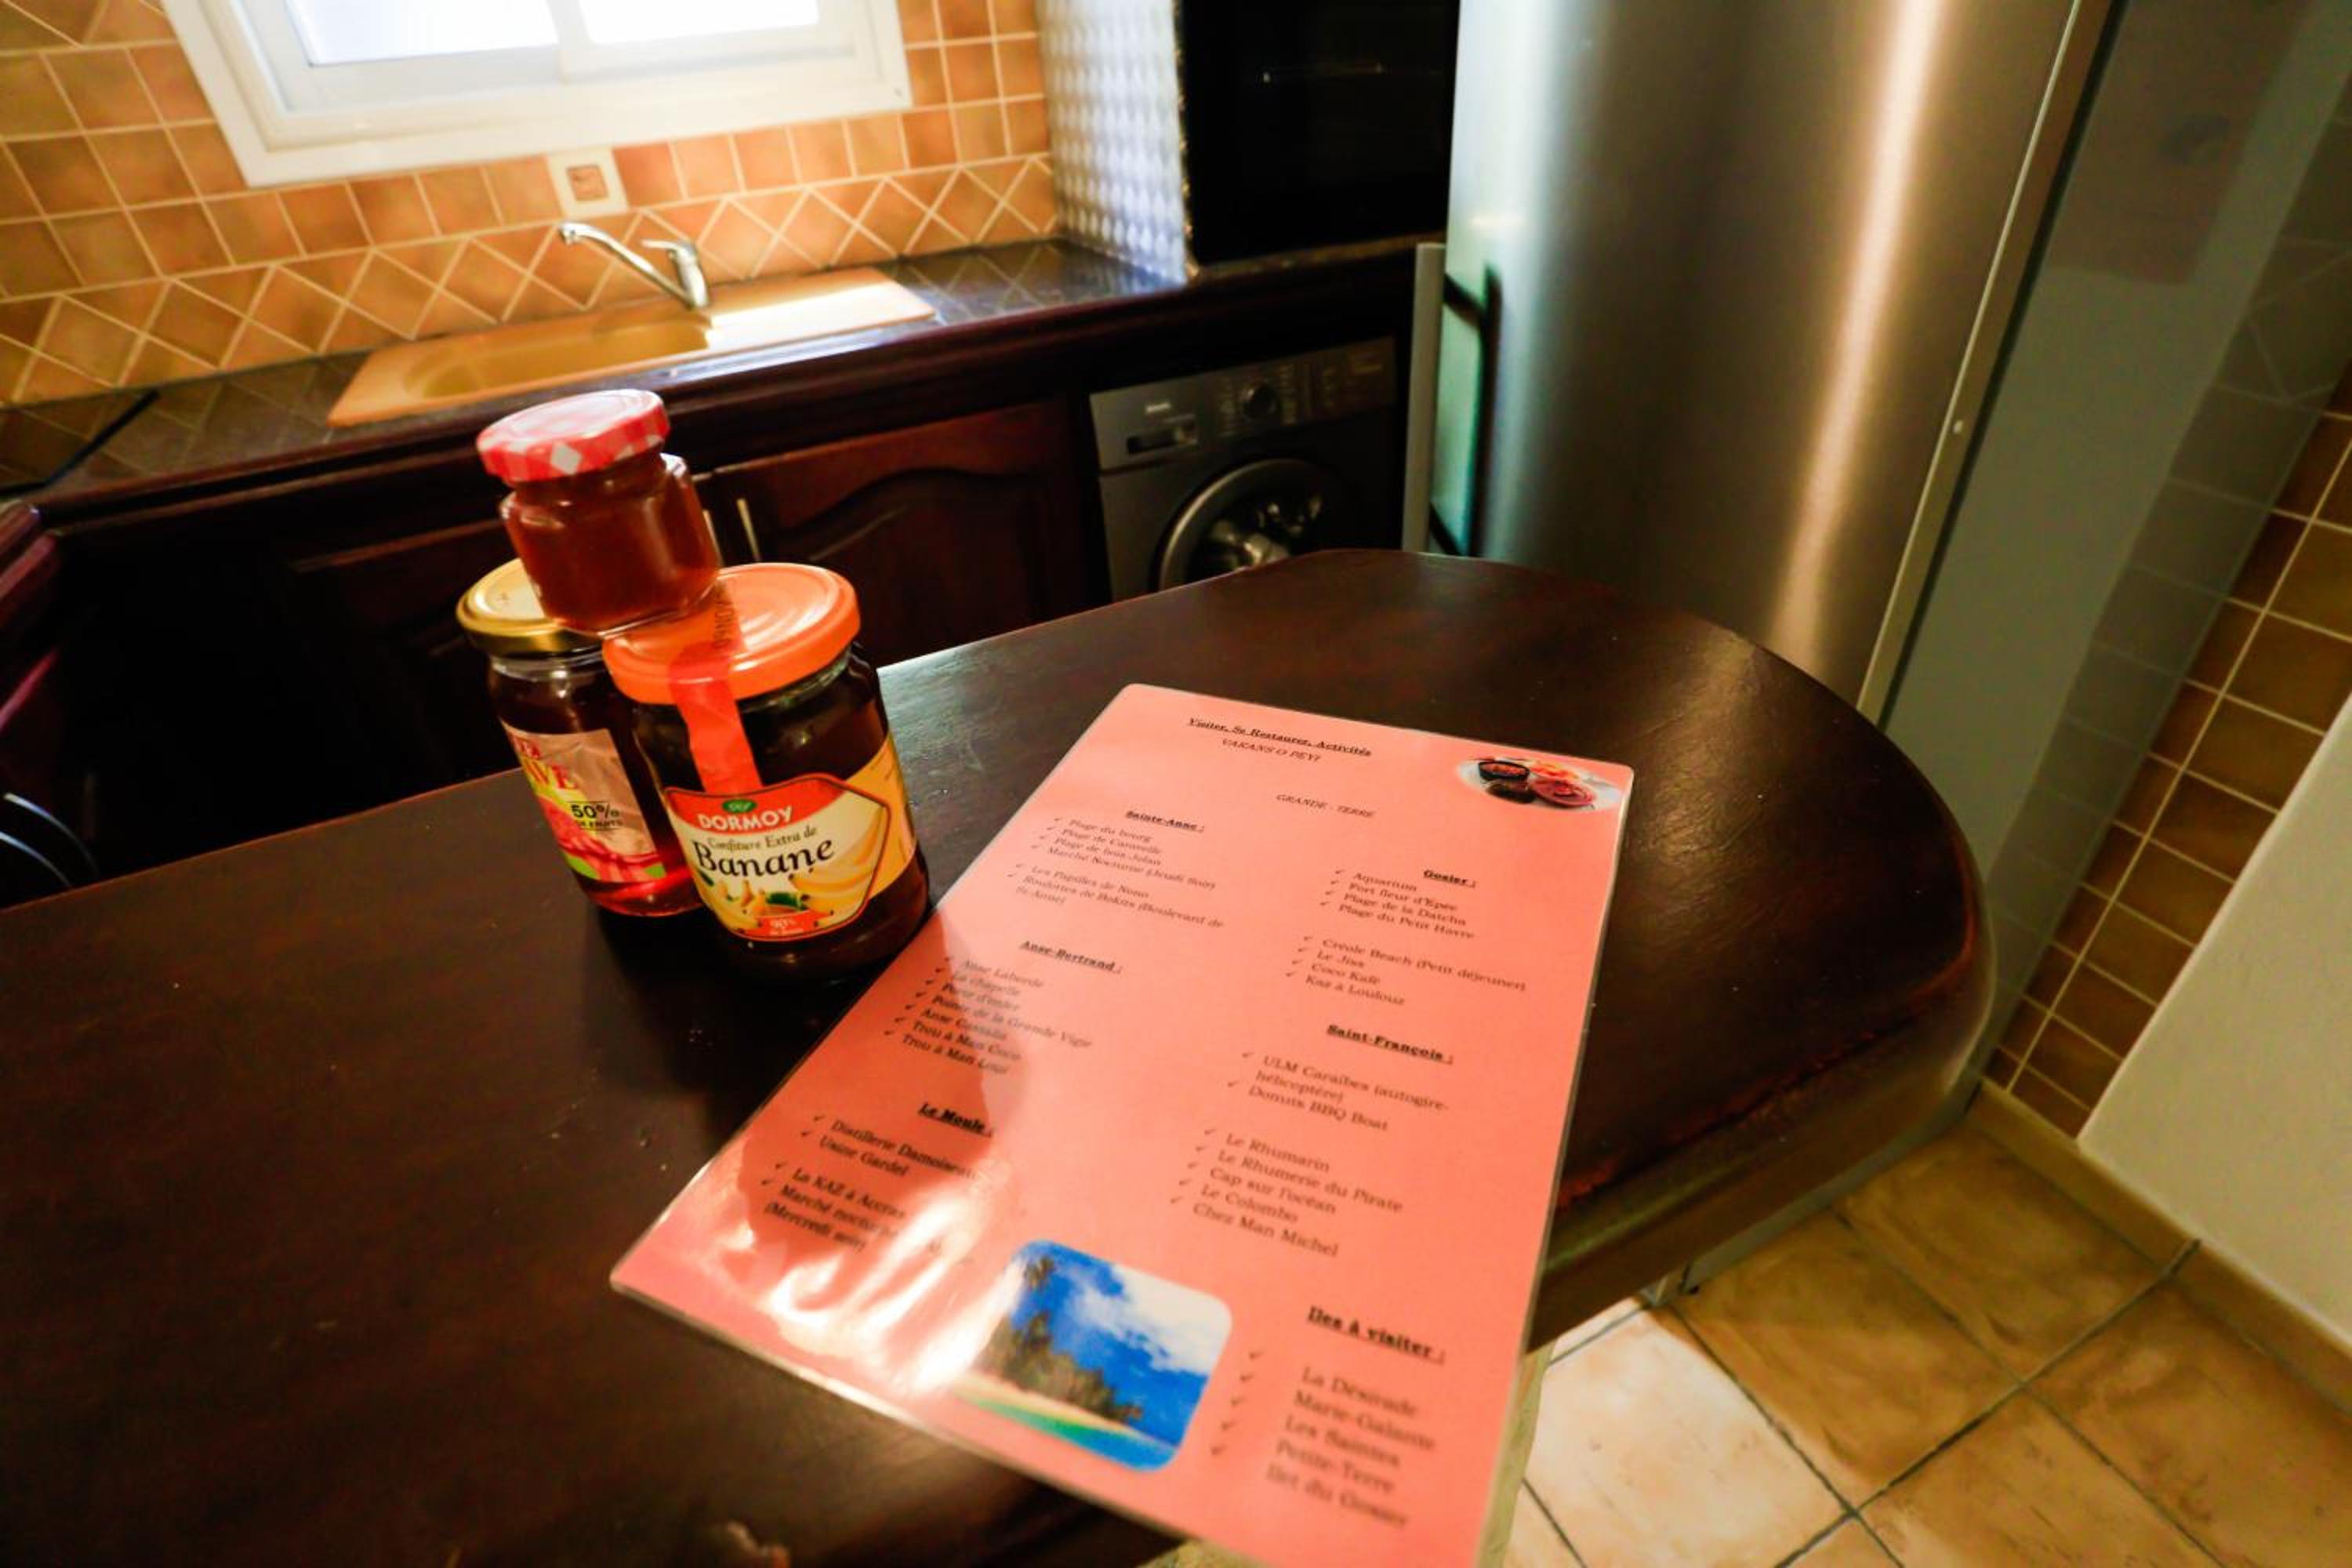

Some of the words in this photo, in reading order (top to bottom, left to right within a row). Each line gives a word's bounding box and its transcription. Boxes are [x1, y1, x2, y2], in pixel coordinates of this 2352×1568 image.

[1250, 728, 1312, 748] Restaurer,
[570, 802, 621, 820] 50%
[697, 804, 794, 832] DORMOY
[764, 832, 801, 849] Extra
[804, 824, 818, 838] de
[690, 839, 836, 878] Banane
[1353, 871, 1418, 893] Aquarium
[1423, 868, 1468, 886] Gosier
[1343, 892, 1378, 908] Plage
[1381, 901, 1399, 911] de
[1338, 903, 1374, 919] Plage
[1377, 911, 1396, 924] du
[1316, 949, 1333, 961] Le
[1370, 947, 1413, 967] Beach
[1327, 1023, 1444, 1062] Saint-François
[1261, 1054, 1299, 1074] ULM
[916, 1101, 938, 1119] Le
[1247, 1084, 1305, 1109] Donuts
[1308, 1099, 1347, 1123] BBQ
[1225, 1132, 1245, 1148] Le
[1248, 1138, 1330, 1174] Rhumarin
[1209, 1166, 1243, 1188] Cap
[1246, 1180, 1275, 1196] sur
[1217, 1149, 1236, 1164] Le
[1324, 1181, 1348, 1199] du
[1352, 1187, 1404, 1214] Pirate
[1201, 1183, 1221, 1200] Le
[1224, 1191, 1300, 1224] Colombo
[1192, 1202, 1235, 1225] Chez
[1238, 1215, 1276, 1240] Man
[1280, 1229, 1340, 1258] Michel
[1367, 1327, 1433, 1360] visiter
[1301, 1366, 1326, 1388] La
